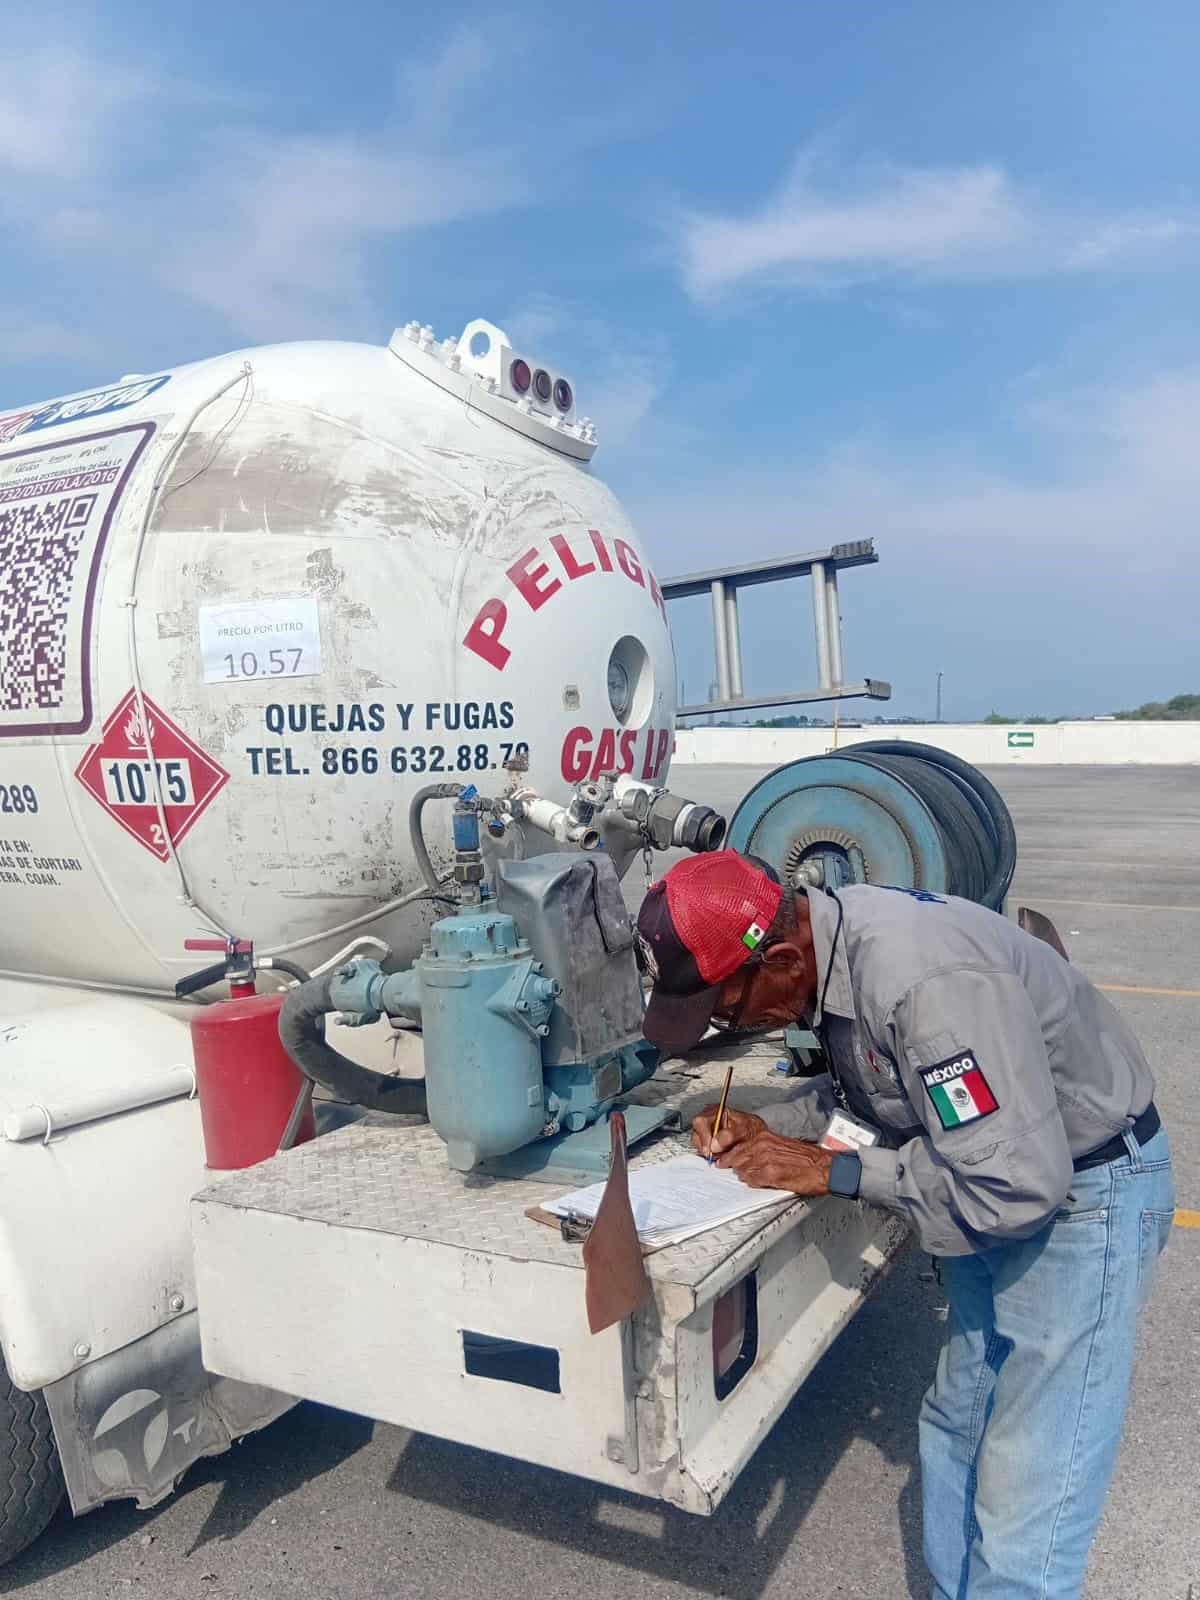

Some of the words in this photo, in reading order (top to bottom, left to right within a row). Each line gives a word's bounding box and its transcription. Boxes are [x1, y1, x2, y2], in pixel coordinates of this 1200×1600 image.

[218, 626, 250, 637] PRECIO
[253, 623, 273, 634] POR
[275, 622, 304, 633] LITRO
[224, 648, 303, 678] 10.57
[265, 703, 385, 735] QUEJAS
[396, 703, 414, 730] Y
[426, 701, 514, 731] FUGAS
[246, 747, 310, 775] TEL.
[322, 747, 378, 775] 866
[561, 726, 638, 783] GAS
[641, 729, 669, 779] LP
[109, 763, 186, 803] 1075
[0, 785, 38, 813] 289
[13, 840, 33, 852] EN:
[16, 857, 32, 868] DE
[25, 873, 61, 886] COAH.
[924, 1058, 973, 1086] MÉXICO
